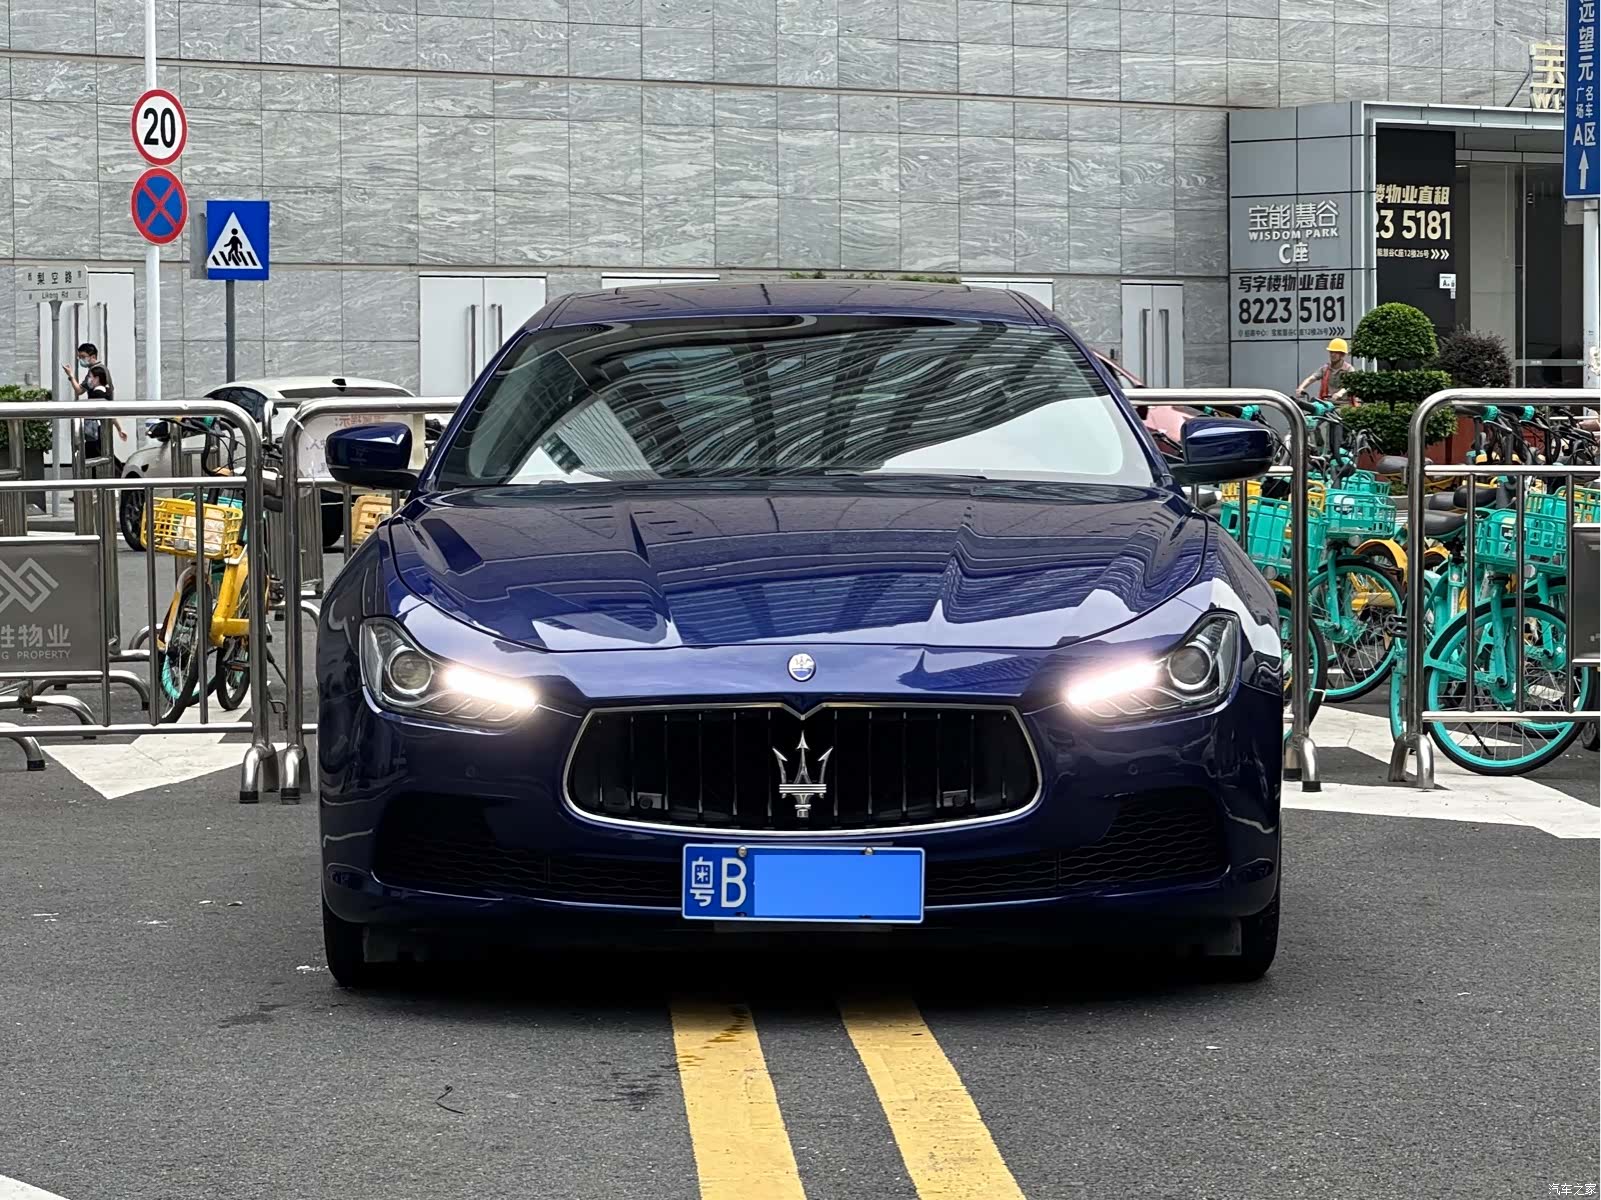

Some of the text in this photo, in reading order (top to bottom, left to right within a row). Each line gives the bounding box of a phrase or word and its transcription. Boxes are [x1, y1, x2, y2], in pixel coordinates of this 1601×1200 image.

[143, 107, 176, 148] 20
[1573, 121, 1597, 147] A区
[1248, 227, 1339, 241] WISDOM PARK
[1402, 209, 1451, 240] 5181
[1278, 242, 1309, 264] C座
[1237, 273, 1345, 293] 写字楼物业直租
[1239, 296, 1345, 324] 8223 5181
[17, 649, 72, 660] PROPERTY
